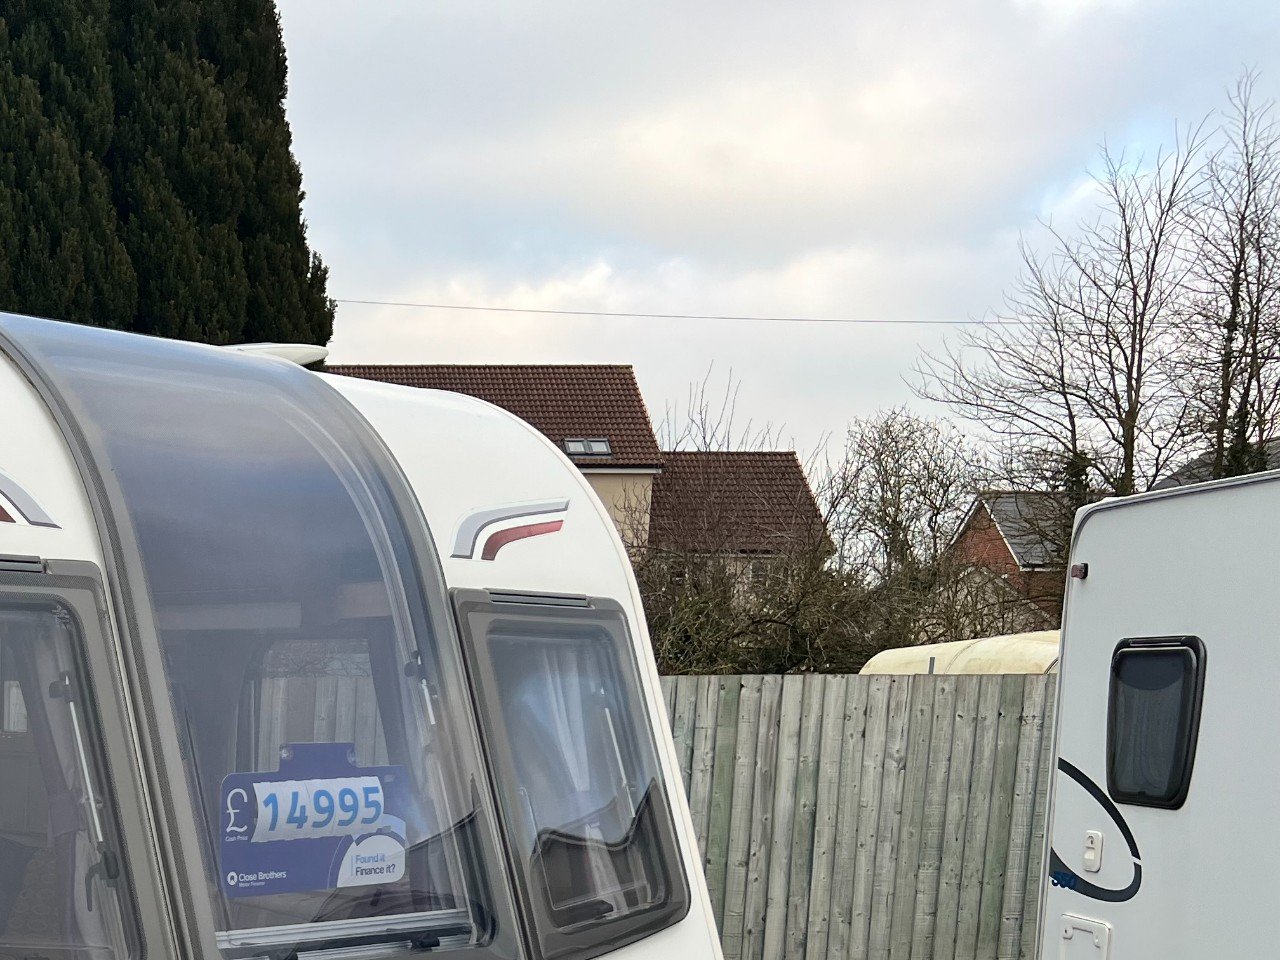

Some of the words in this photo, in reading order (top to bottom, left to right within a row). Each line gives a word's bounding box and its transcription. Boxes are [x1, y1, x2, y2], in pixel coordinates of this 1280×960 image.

[263, 786, 383, 832] 14995
[355, 853, 379, 864] Found
[355, 865, 385, 876] Finance
[385, 863, 396, 874] it?
[238, 873, 258, 882] Close
[258, 871, 287, 880] Brothers
